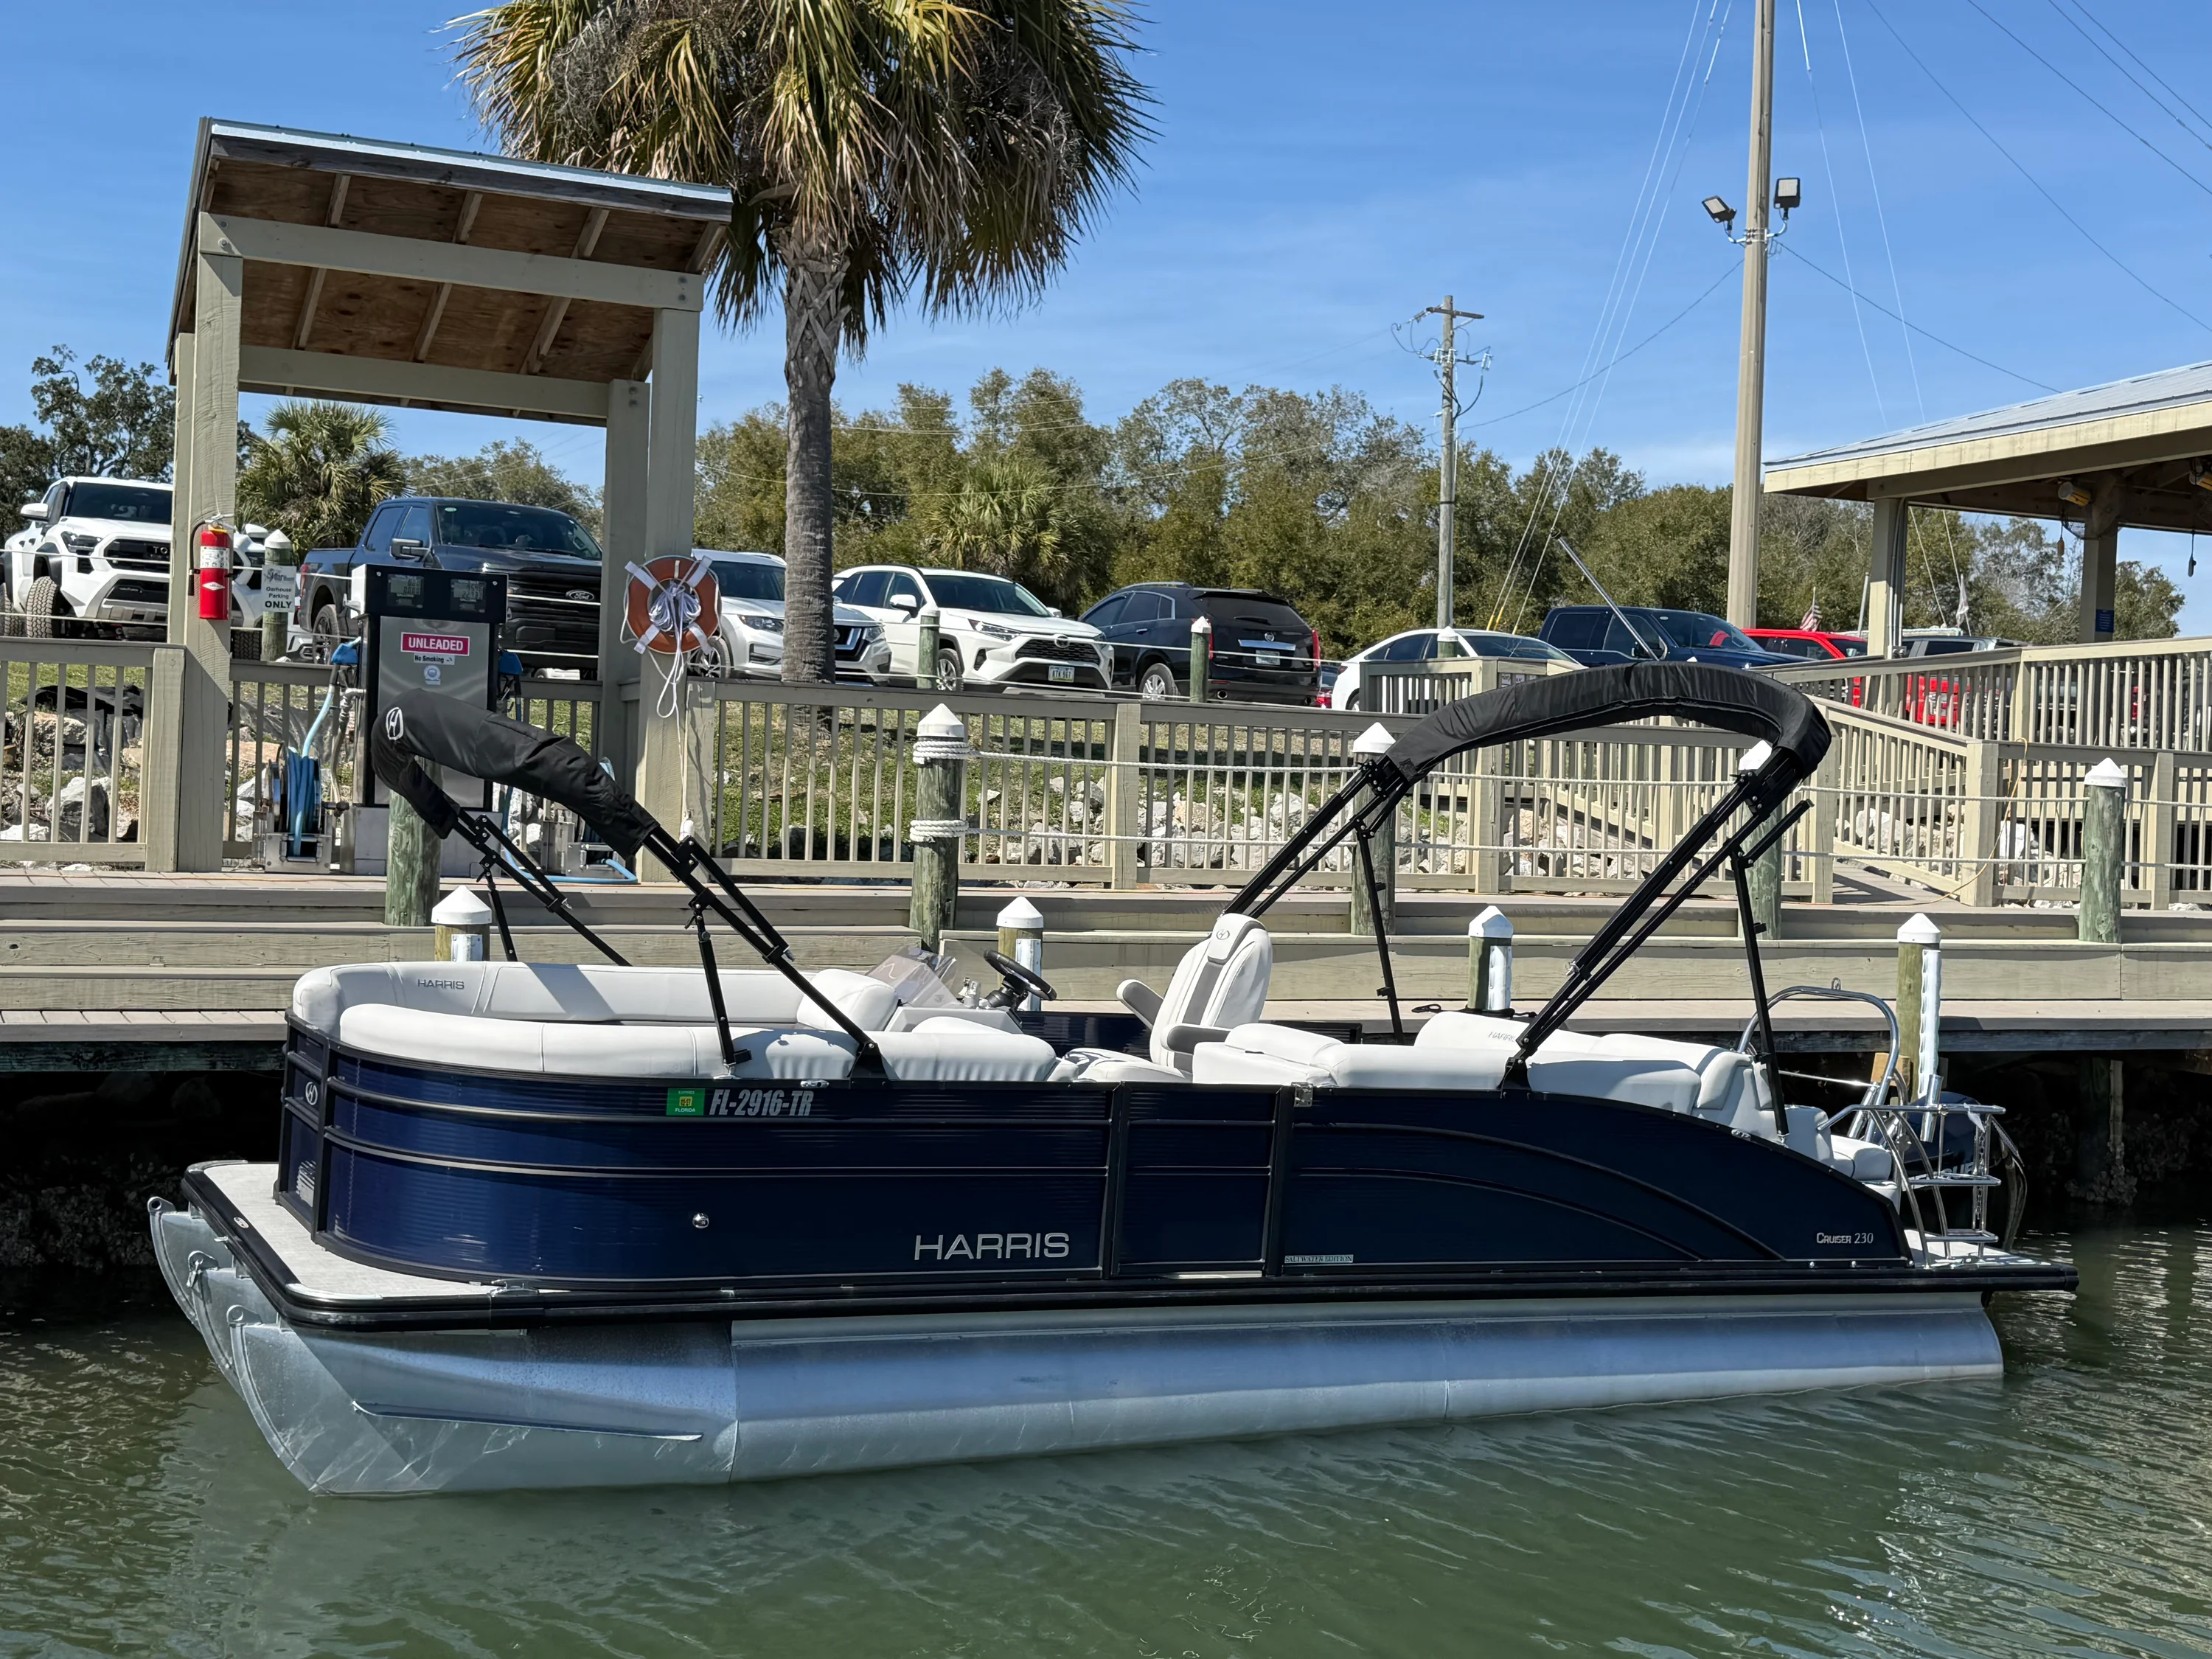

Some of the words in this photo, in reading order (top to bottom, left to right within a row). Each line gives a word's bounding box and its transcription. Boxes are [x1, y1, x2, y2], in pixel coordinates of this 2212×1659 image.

[265, 600, 292, 608] ONLY
[408, 637, 464, 651] UNLEADED
[423, 655, 444, 664] Smoking
[417, 978, 465, 990] HARRIS
[709, 1089, 815, 1116] FL-2916-TR
[1854, 1233, 1874, 1244] 230
[914, 1232, 1069, 1260] HARRIS
